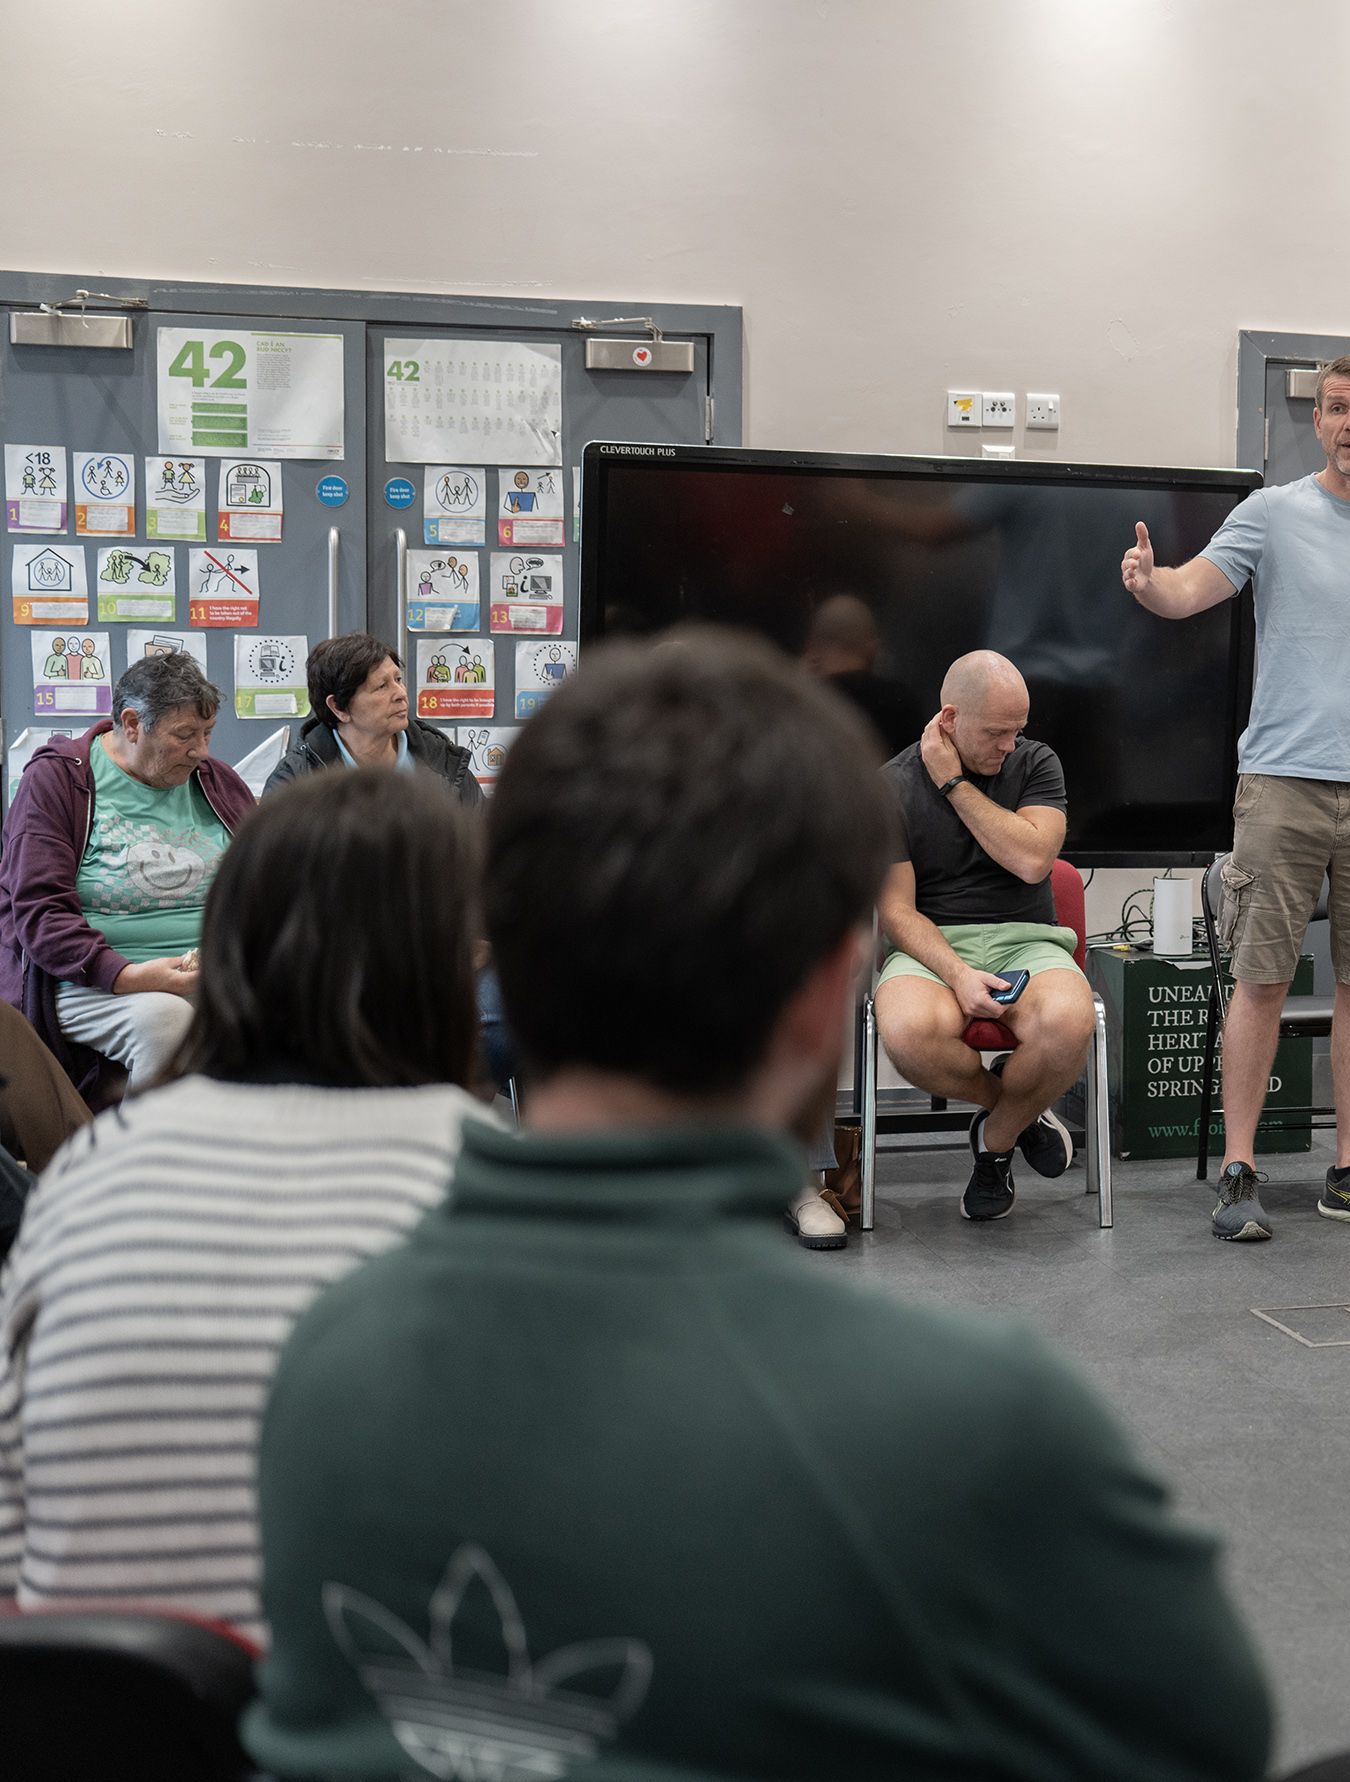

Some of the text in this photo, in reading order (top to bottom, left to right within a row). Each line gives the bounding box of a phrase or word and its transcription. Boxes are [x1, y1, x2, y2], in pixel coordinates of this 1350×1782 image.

[168, 340, 247, 389] 42
[386, 360, 420, 382] 42
[600, 445, 676, 456] CLEVERTOUCH PLUS
[9, 508, 18, 520] 1
[78, 512, 86, 525] 2
[149, 517, 156, 530] 3
[220, 520, 228, 531] 4
[430, 525, 437, 536] 5
[503, 526, 512, 538] 6
[20, 604, 30, 616] 9
[100, 602, 116, 614] 10
[190, 608, 206, 620] 11
[408, 609, 424, 621] 12
[492, 611, 508, 624] 13
[37, 692, 54, 705] 15
[237, 696, 252, 708] 17
[421, 697, 438, 708] 18
[521, 698, 535, 709] 19
[1146, 1010, 1194, 1026] THE
[1147, 1057, 1174, 1074] OF
